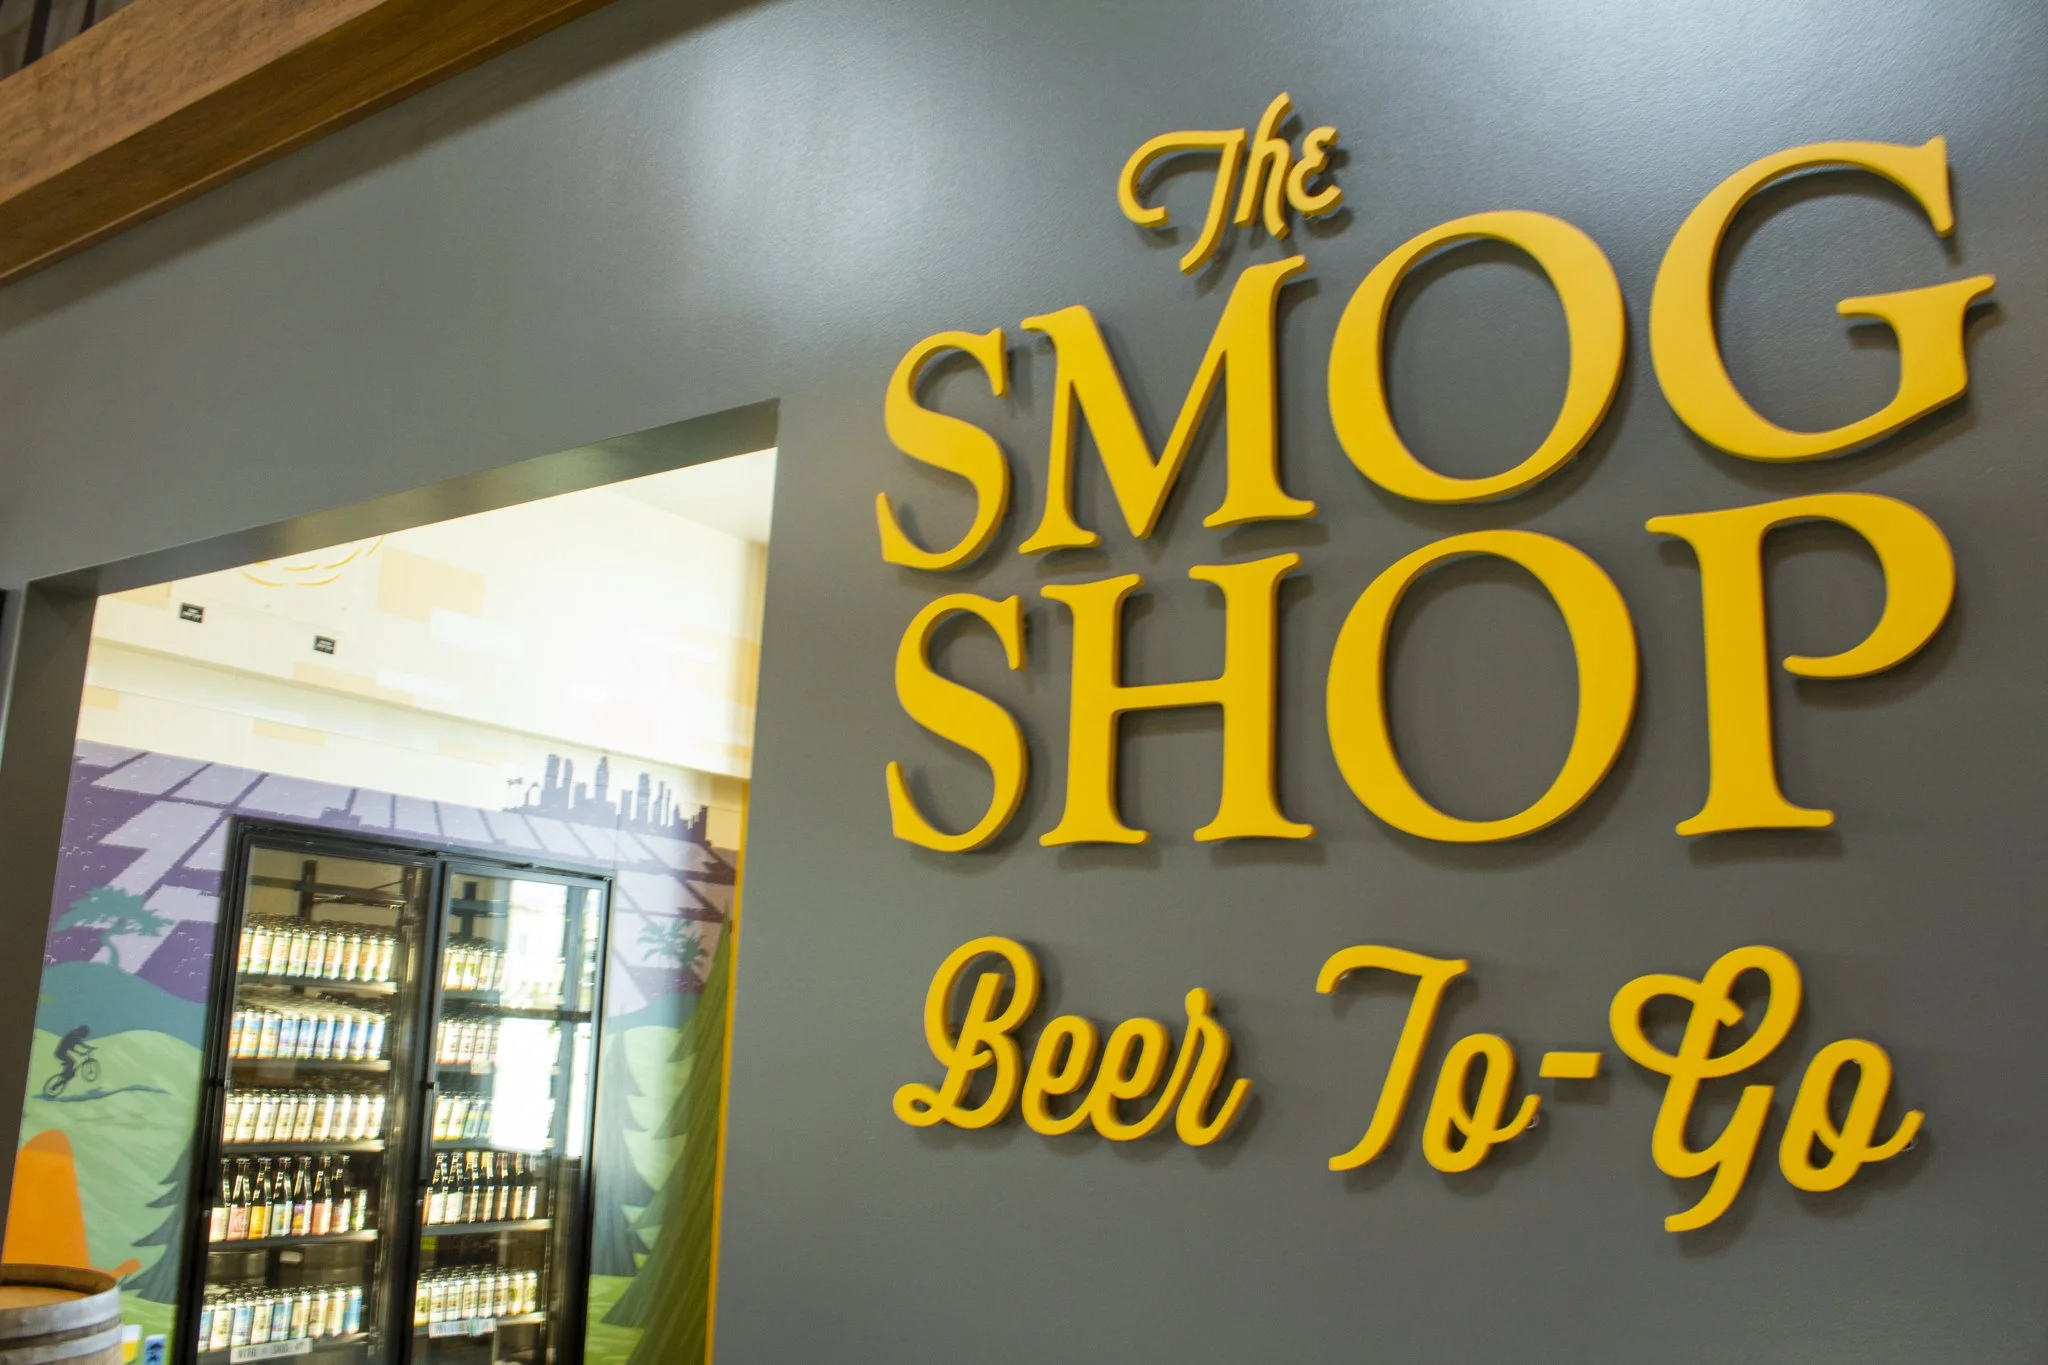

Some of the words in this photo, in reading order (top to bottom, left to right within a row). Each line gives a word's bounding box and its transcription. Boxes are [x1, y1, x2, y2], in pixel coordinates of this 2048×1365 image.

[1119, 94, 1342, 273] The
[876, 137, 1996, 571] SMOG
[886, 493, 1956, 853] SHOP
[893, 936, 1252, 1147] Beer
[1316, 945, 1925, 1233] To-Go
